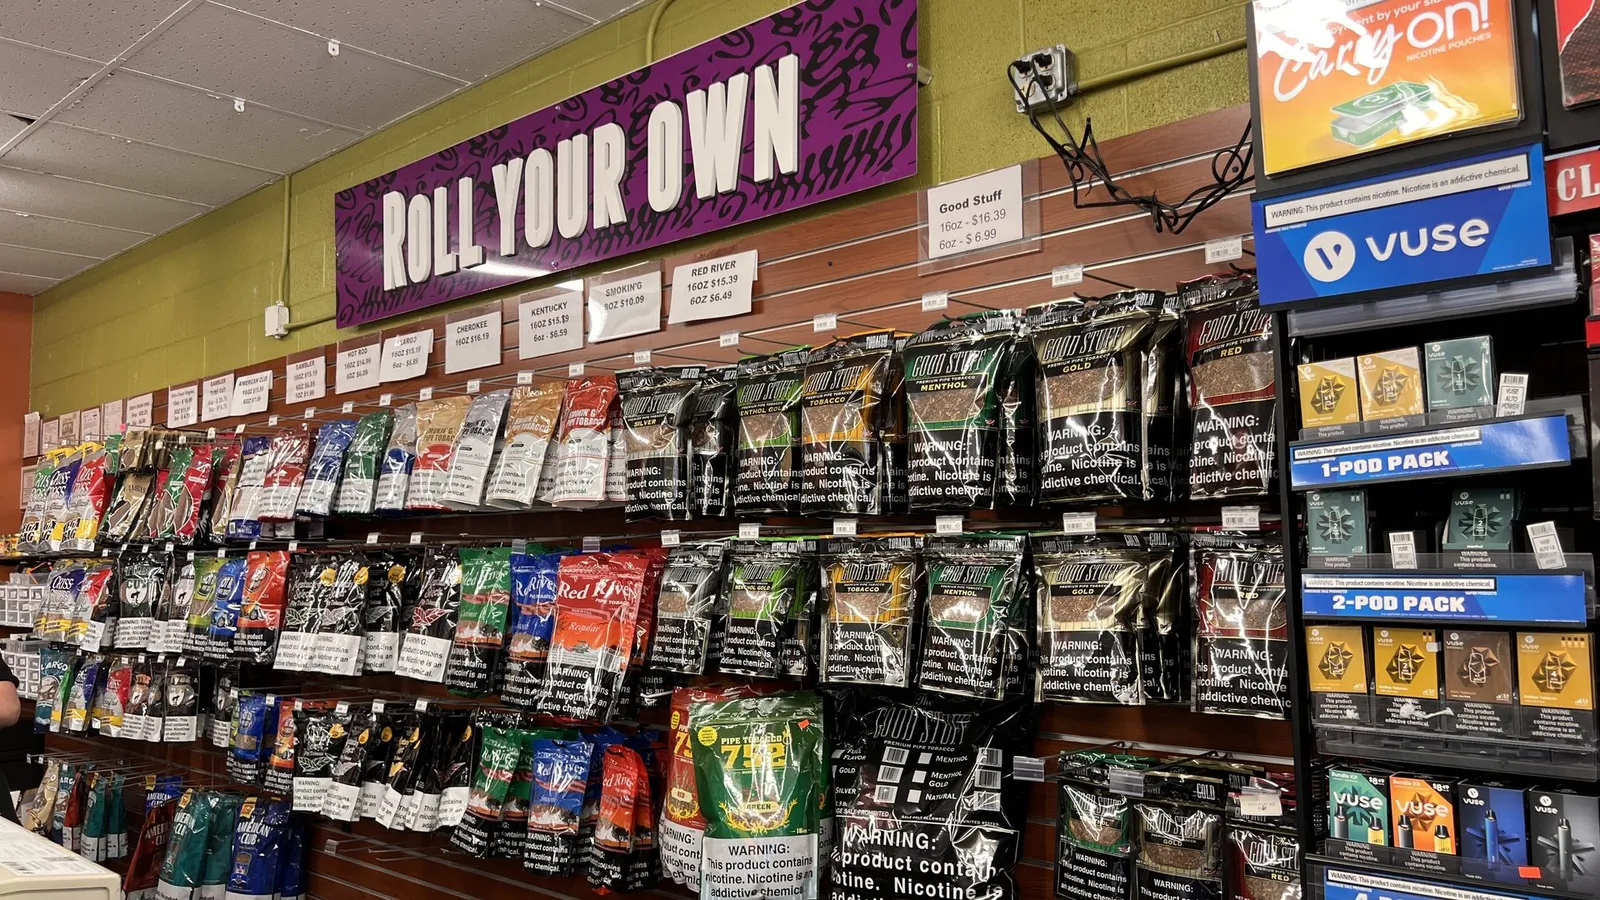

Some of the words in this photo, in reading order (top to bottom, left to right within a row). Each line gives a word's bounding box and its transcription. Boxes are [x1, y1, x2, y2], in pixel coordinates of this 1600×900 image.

[1377, 9, 1391, 21] by
[1394, 3, 1420, 18] your
[1406, 0, 1490, 48] on!
[1407, 44, 1446, 62] NICOTINE
[1448, 32, 1492, 50] POUCHES
[383, 176, 486, 291] ROLL
[491, 121, 628, 258] YOUR
[647, 53, 801, 214] OWN
[1271, 206, 1304, 219] WARNING:
[1305, 203, 1318, 213] This
[1319, 200, 1343, 212] product
[1344, 194, 1371, 205] contains
[1372, 189, 1400, 200] nicotine.
[1401, 182, 1431, 194] Nicotine
[1432, 180, 1439, 188] is
[1440, 179, 1449, 187] an
[1450, 172, 1483, 185] addictive
[1484, 164, 1521, 178] chemical.
[939, 198, 969, 214] Good
[973, 189, 1003, 207] Stuff
[940, 219, 963, 233] 16oz
[971, 208, 1006, 228] $16.39
[939, 239, 956, 250] 6oz
[966, 233, 973, 245] $
[974, 228, 997, 243] 6.99
[1365, 219, 1490, 262] vuse
[691, 264, 711, 278] RED
[712, 260, 737, 275] RIVER
[605, 281, 643, 298] SMOKIN'G
[687, 279, 709, 293] 16OZ
[711, 274, 738, 290] $15.39
[604, 299, 619, 311] 8OZ
[620, 295, 645, 309] $10.09
[690, 294, 707, 306] 6OZ
[709, 290, 733, 304] $6.49
[531, 302, 567, 317] KENTUCKY
[457, 320, 488, 334] CHEROKEE
[530, 318, 546, 330] 16OZ
[455, 335, 469, 347] 16OZ
[470, 332, 489, 344] $16.19
[533, 333, 545, 343] 6oz
[550, 327, 568, 340] $6.59
[348, 350, 357, 358] HOT
[358, 348, 368, 356] ROD
[1220, 346, 1242, 358] RED
[912, 353, 945, 378] GOOD
[1062, 362, 1092, 373] GOLD
[921, 382, 968, 391] MENTHOL
[810, 396, 846, 407] TOBACCO
[634, 419, 657, 428] SILVER
[914, 441, 967, 452] WARNING:
[1334, 446, 1351, 454] product
[1352, 443, 1371, 451] contains
[1372, 441, 1392, 449] nicotine.
[1393, 438, 1414, 446] Nicotine
[1427, 434, 1450, 442] addictive
[912, 456, 946, 469] product
[1126, 455, 1137, 467] is
[1321, 457, 1382, 478] 1-POD
[1387, 450, 1450, 471] PACK
[983, 470, 991, 482] is
[1056, 564, 1085, 582] GOOD
[558, 581, 590, 600] Red
[1345, 580, 1363, 588] product
[1465, 580, 1492, 588] chemical.
[943, 589, 977, 597] MENTHOL
[1333, 594, 1398, 611] 2-POD
[1403, 596, 1466, 612] PACK
[931, 635, 974, 649] WARNING:
[1053, 640, 1102, 651] WARNING:
[928, 649, 958, 661] product
[1050, 654, 1084, 667] product
[1087, 655, 1132, 665] contains
[874, 706, 919, 742] GOOD
[920, 709, 973, 745] STUFF
[721, 737, 740, 745] PIPE
[743, 735, 783, 745] TOBACCO
[936, 755, 968, 764] MENTHOL
[839, 766, 856, 774] GOLD
[931, 771, 963, 780] MENTHOL
[835, 786, 857, 795] SILVER
[925, 793, 957, 801] NATURAL
[1333, 791, 1384, 810] vuse
[1462, 797, 1485, 806] vuse
[1395, 800, 1449, 817] vuse
[1534, 805, 1559, 815] vuse
[728, 844, 790, 856] WARNING:
[707, 858, 723, 870] This
[725, 858, 770, 873] product
[772, 855, 814, 867] contains
[842, 851, 912, 870] product
[1075, 852, 1108, 867] WARNING:
[705, 871, 746, 885] nicotine.
[747, 871, 793, 884] Nicotine
[795, 870, 804, 880] is
[1073, 863, 1095, 876] product
[1096, 872, 1127, 883] contains
[1271, 873, 1290, 881] RED
[1088, 879, 1116, 893] Nicotine
[1154, 878, 1194, 893] WARNING:
[1330, 871, 1358, 883] WARNING:
[1359, 876, 1369, 884] This
[1370, 878, 1388, 889] product
[1388, 881, 1409, 890] contains
[1410, 884, 1431, 894] nicotine.
[1432, 887, 1455, 896] Nicotine
[711, 885, 758, 898] addictive
